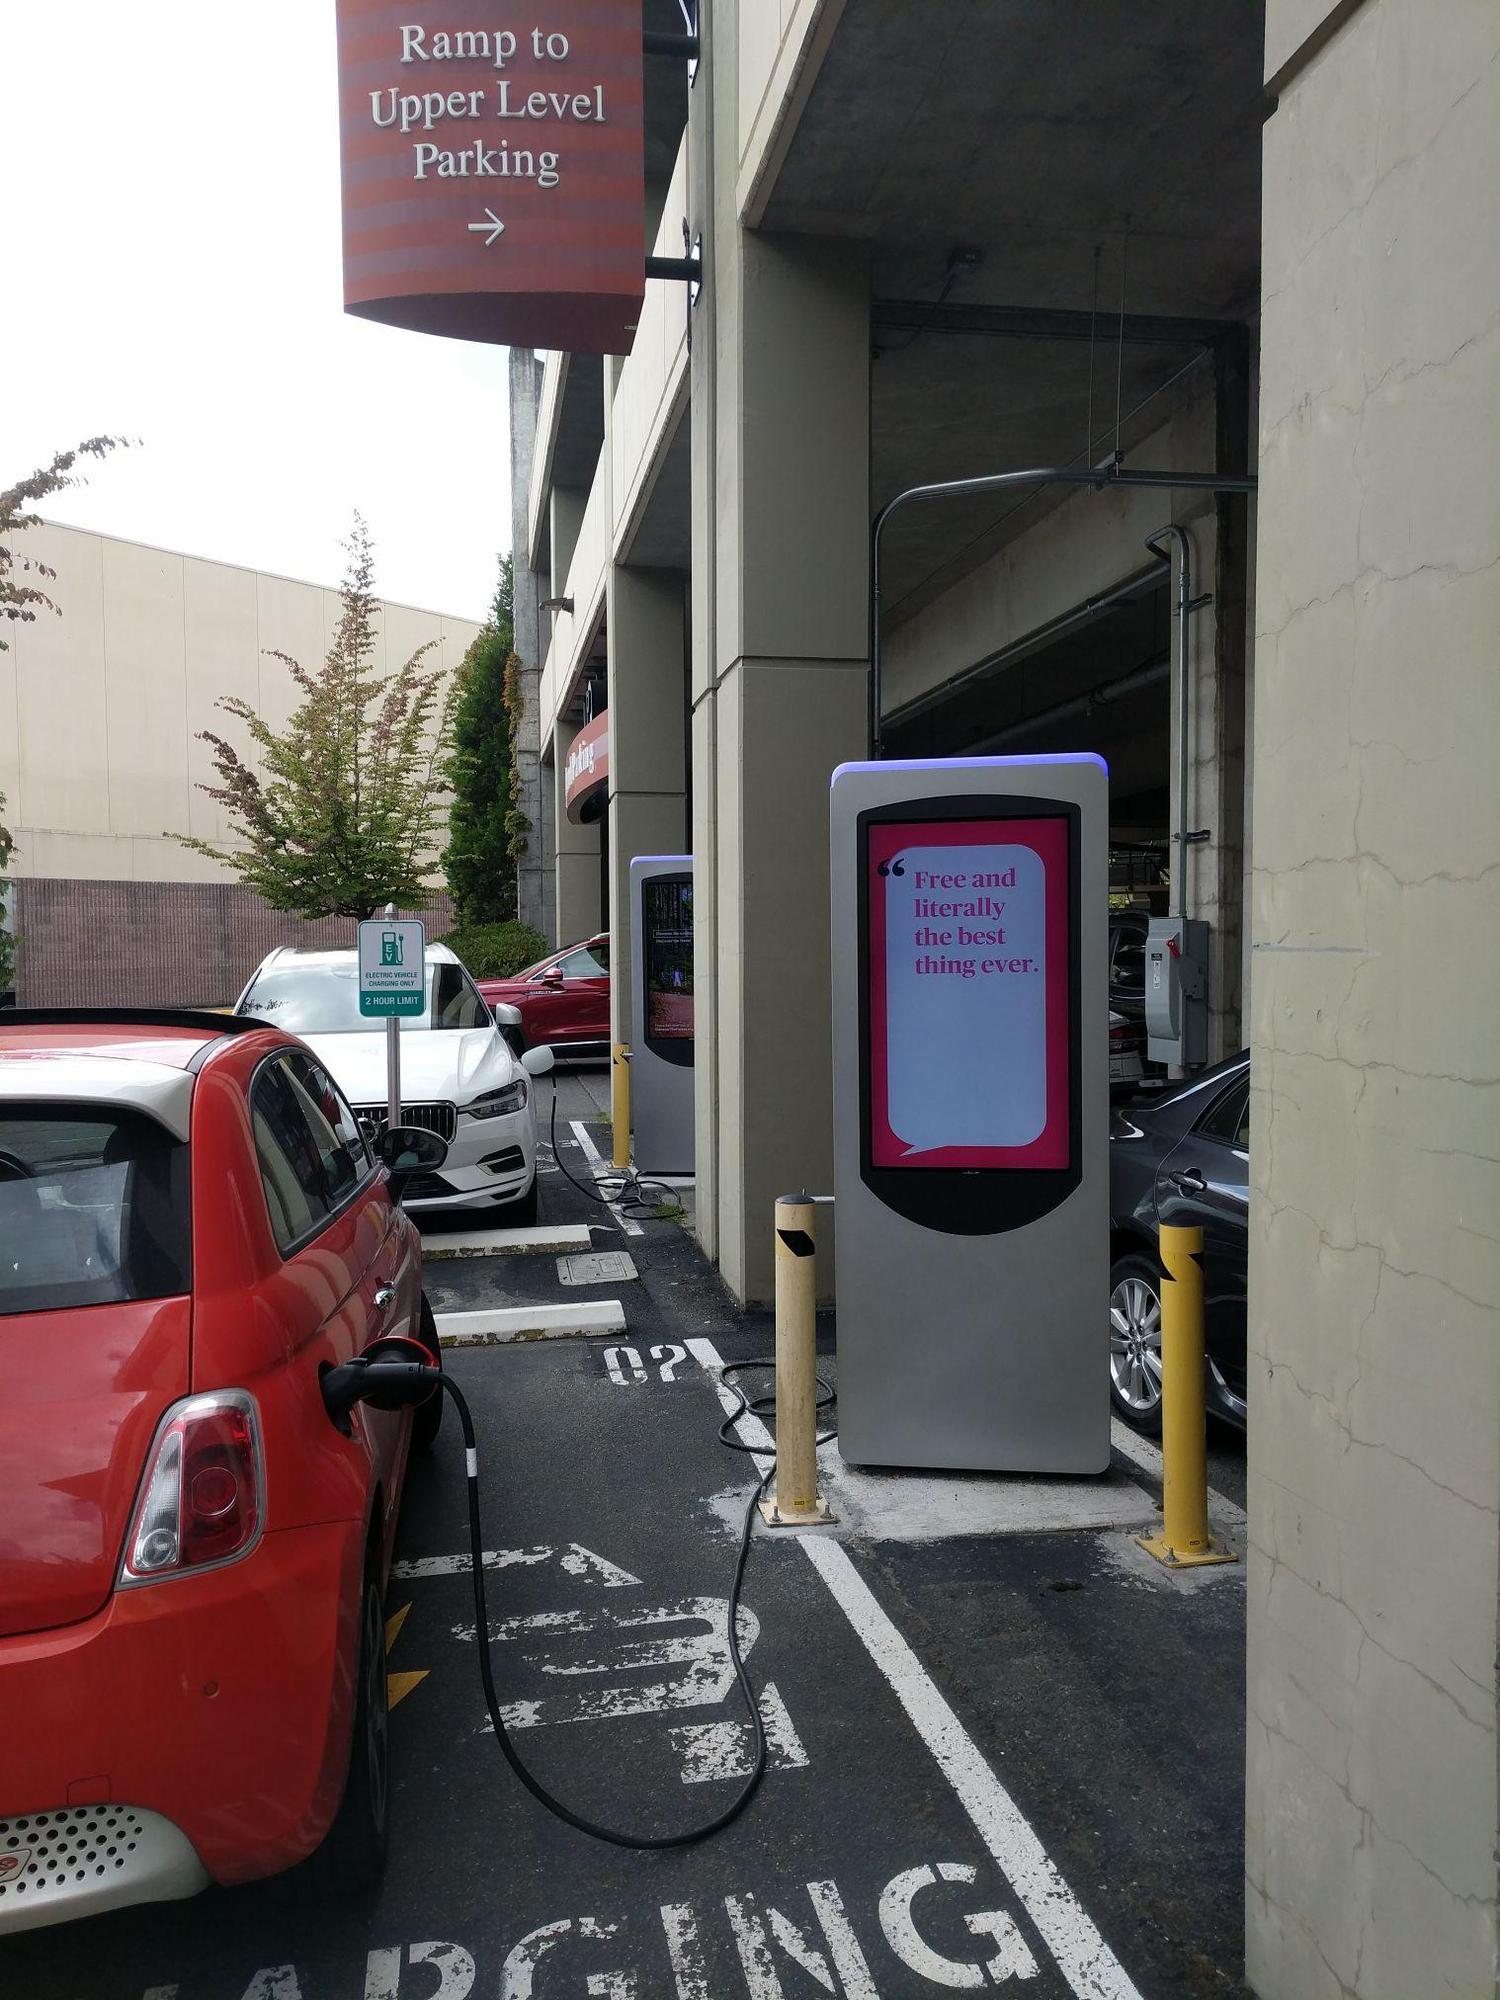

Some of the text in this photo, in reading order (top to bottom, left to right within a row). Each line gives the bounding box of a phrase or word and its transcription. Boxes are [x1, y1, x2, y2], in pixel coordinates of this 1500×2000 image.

[399, 24, 570, 69] Ramp to
[368, 80, 607, 133] Upper Level
[412, 139, 560, 188] Parking
[914, 870, 967, 889] Free
[971, 867, 1017, 888] and
[913, 896, 1006, 921] literally
[914, 925, 1006, 946] the best
[914, 955, 1040, 978] thing ever.
[365, 997, 419, 1005] 2 HOUR LIMIT
